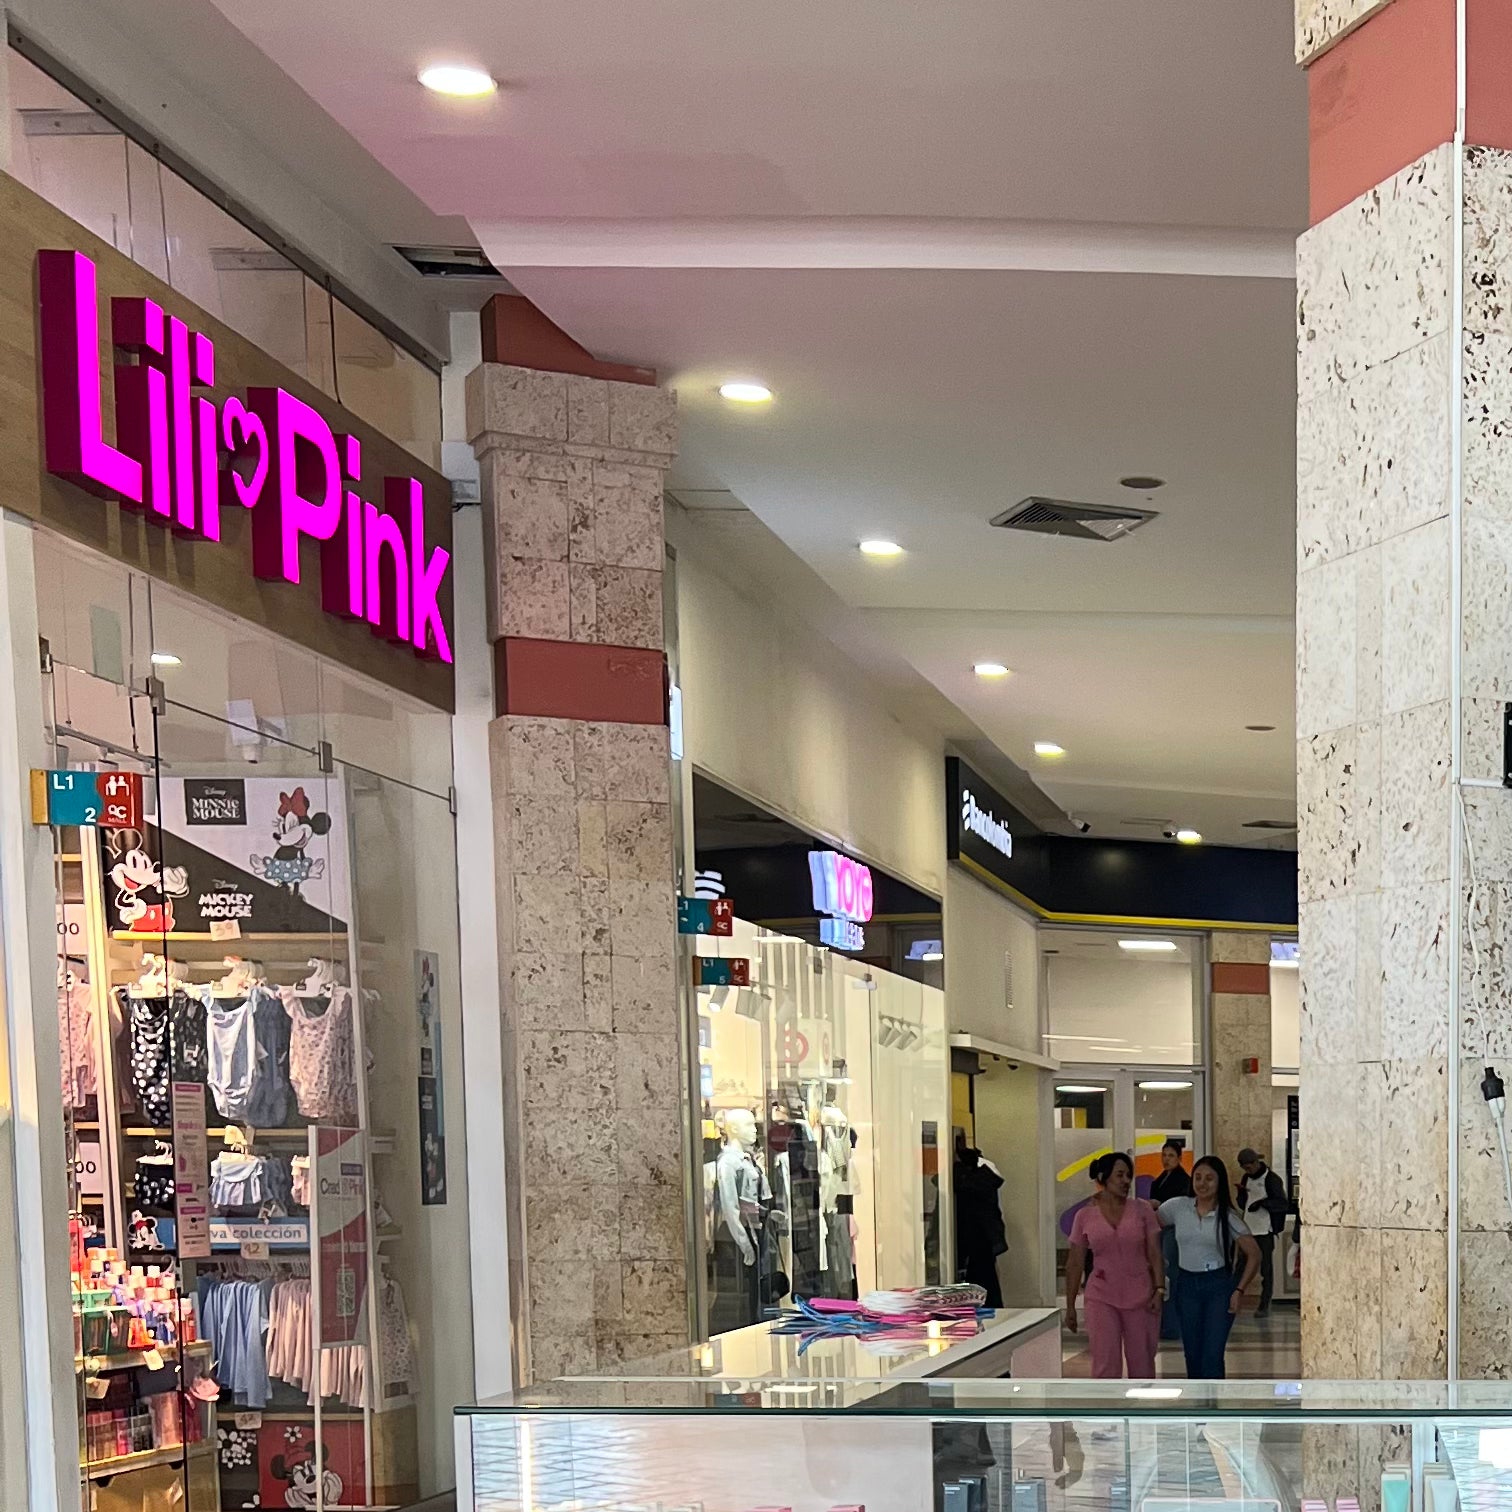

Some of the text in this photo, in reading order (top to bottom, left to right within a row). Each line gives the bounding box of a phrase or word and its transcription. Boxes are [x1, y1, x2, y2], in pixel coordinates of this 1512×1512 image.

[42, 249, 453, 664] Lili Pink
[53, 774, 74, 790] L1
[85, 808, 97, 823] 2
[192, 808, 240, 820] MOUSE
[198, 892, 254, 905] MICKEY
[200, 904, 252, 918] MOUSE
[697, 922, 705, 933] 4
[233, 1226, 302, 1239] colección
